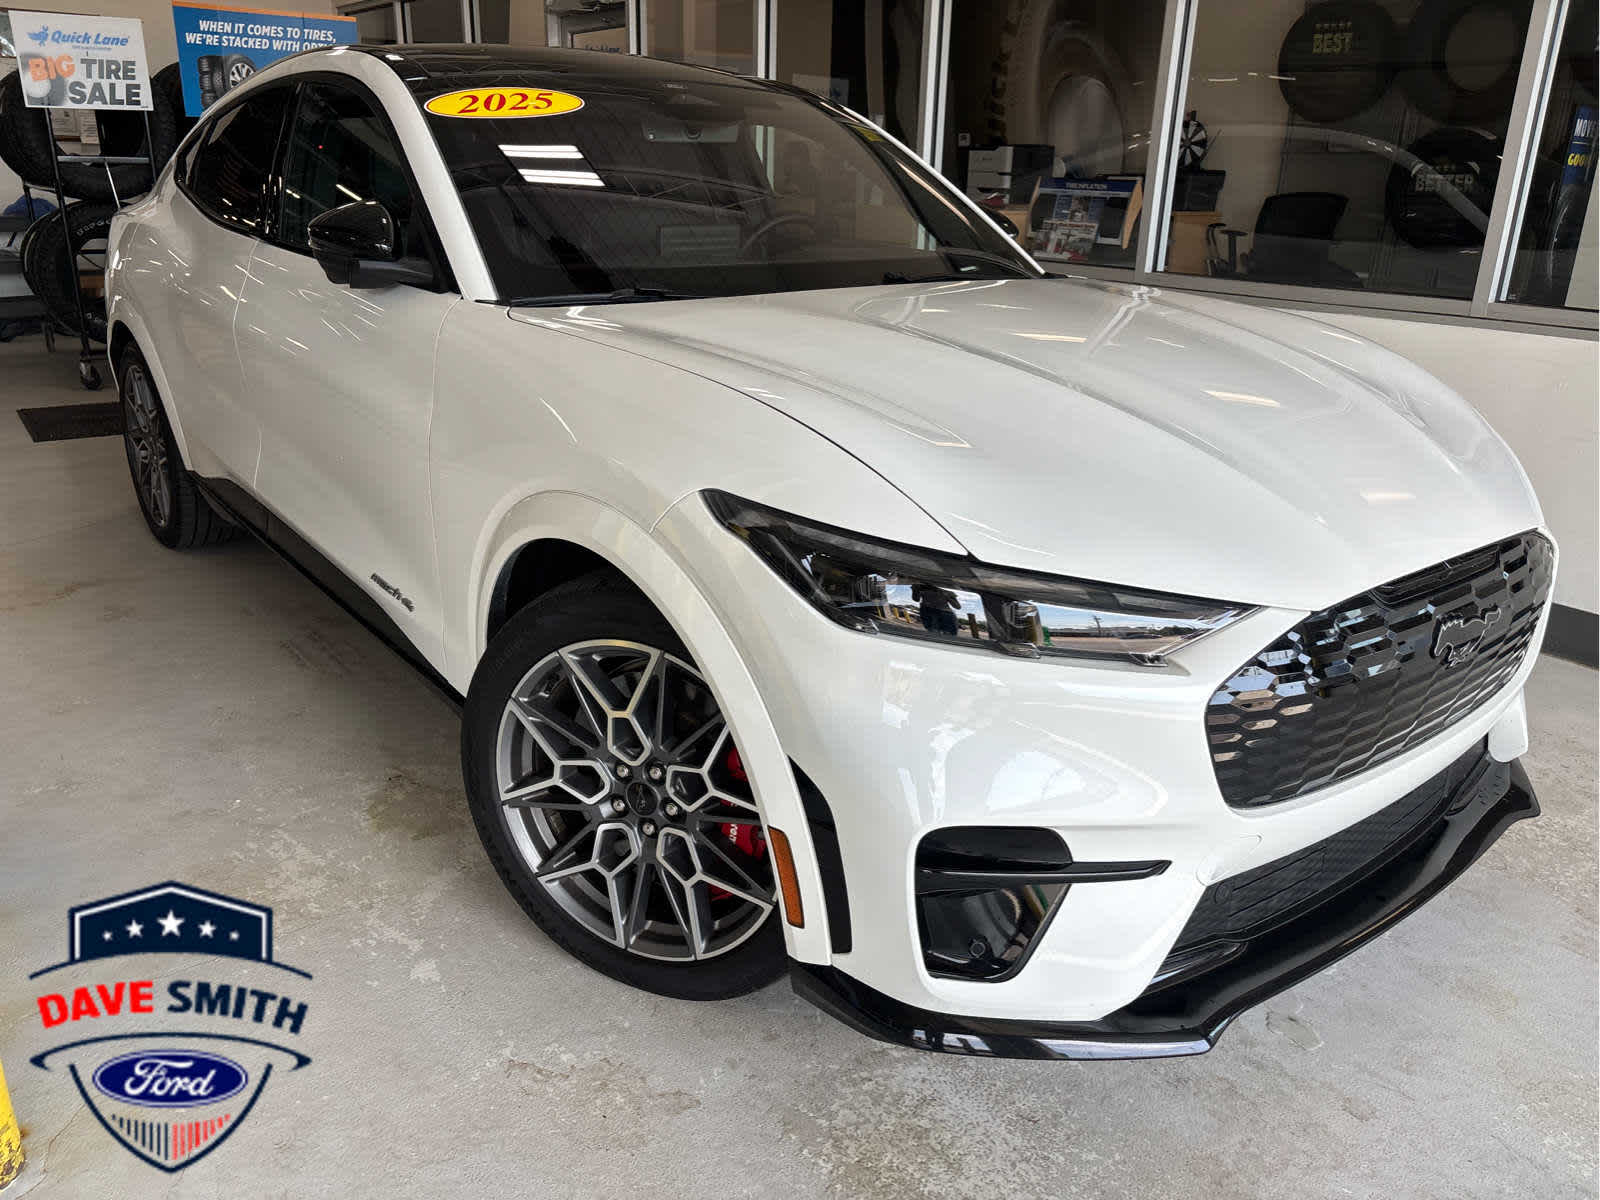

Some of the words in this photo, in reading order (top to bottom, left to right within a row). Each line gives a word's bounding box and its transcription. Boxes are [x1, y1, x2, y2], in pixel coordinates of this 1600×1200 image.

[50, 30, 92, 45] Quick
[94, 32, 129, 47] Lane
[185, 32, 219, 46] WE'RE
[221, 35, 270, 50] STACKED
[272, 40, 300, 52] WITH
[199, 20, 232, 34] WHEN
[234, 23, 246, 34] IT
[247, 24, 285, 38] COMES
[286, 28, 301, 39] TO
[303, 29, 337, 44] TIRES,
[1312, 33, 1354, 55] BEST
[28, 54, 76, 82] BIG
[80, 58, 136, 81] TIRE
[69, 81, 141, 106] SALE
[457, 92, 553, 114] 2025
